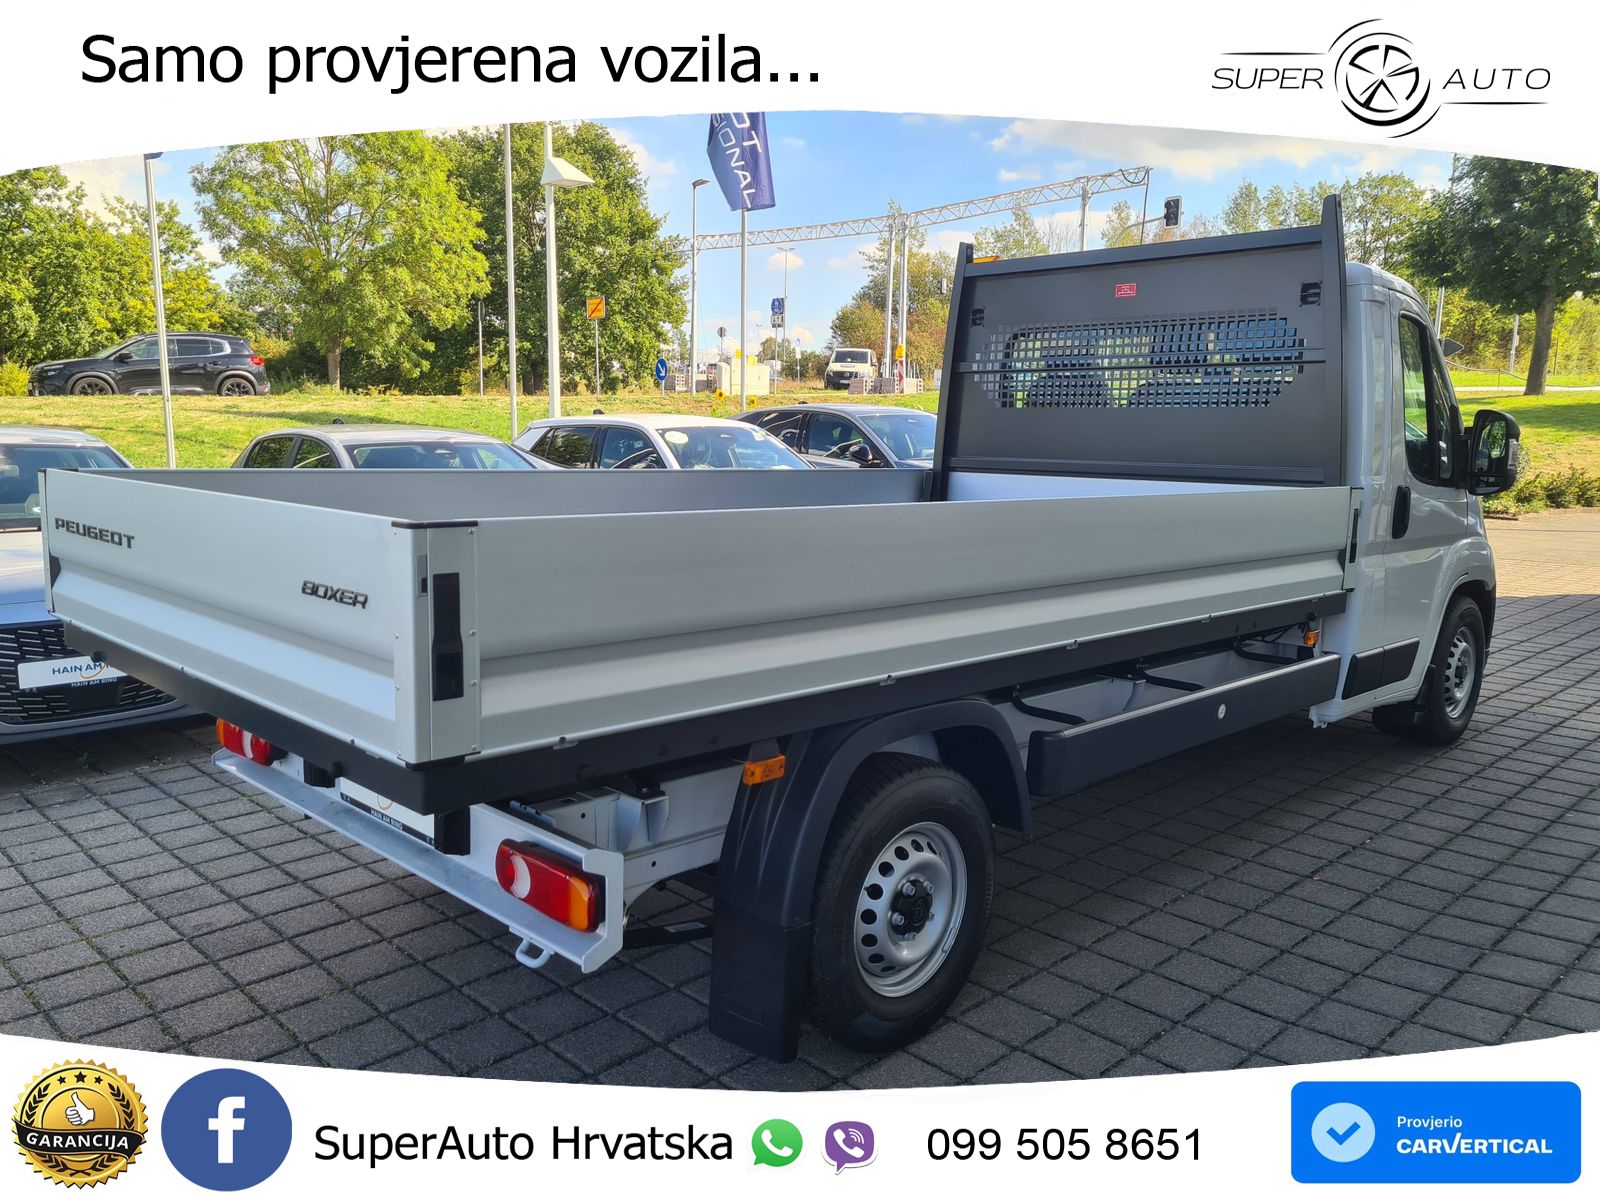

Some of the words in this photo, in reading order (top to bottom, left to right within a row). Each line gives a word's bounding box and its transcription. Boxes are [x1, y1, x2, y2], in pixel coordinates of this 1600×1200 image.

[54, 517, 135, 549] PEUGEOT
[301, 580, 368, 609] BOXER
[52, 665, 82, 675] HAIN
[84, 662, 102, 671] AM
[71, 680, 88, 688] HAIN
